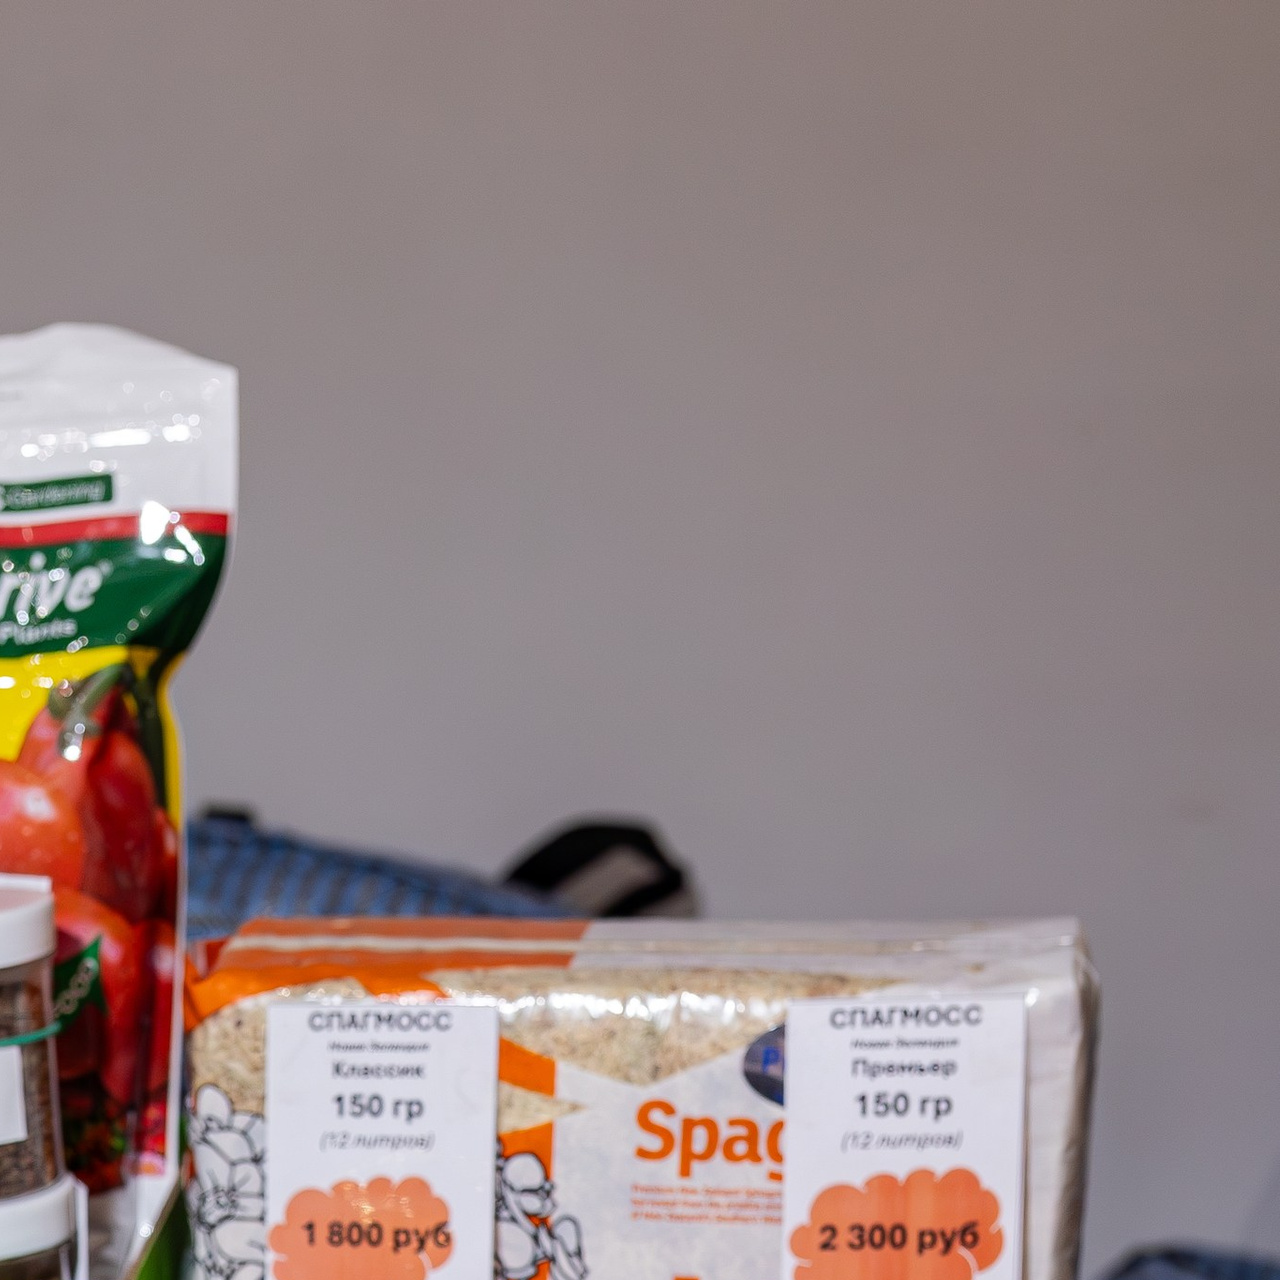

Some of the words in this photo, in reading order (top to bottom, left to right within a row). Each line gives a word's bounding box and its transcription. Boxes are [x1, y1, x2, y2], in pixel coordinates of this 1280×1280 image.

[308, 1011, 453, 1032] СПАГМОСС
[830, 1004, 983, 1030] СПАГМОСС
[333, 1094, 384, 1118] 150
[392, 1099, 424, 1124] гр
[856, 1093, 909, 1117] 150
[920, 1096, 952, 1122] гр
[303, 1222, 315, 1246] 1
[327, 1222, 383, 1248] 800
[393, 1222, 451, 1254] руб
[820, 1226, 838, 1250] 2
[847, 1224, 908, 1250] 300
[918, 1222, 980, 1256] руб
